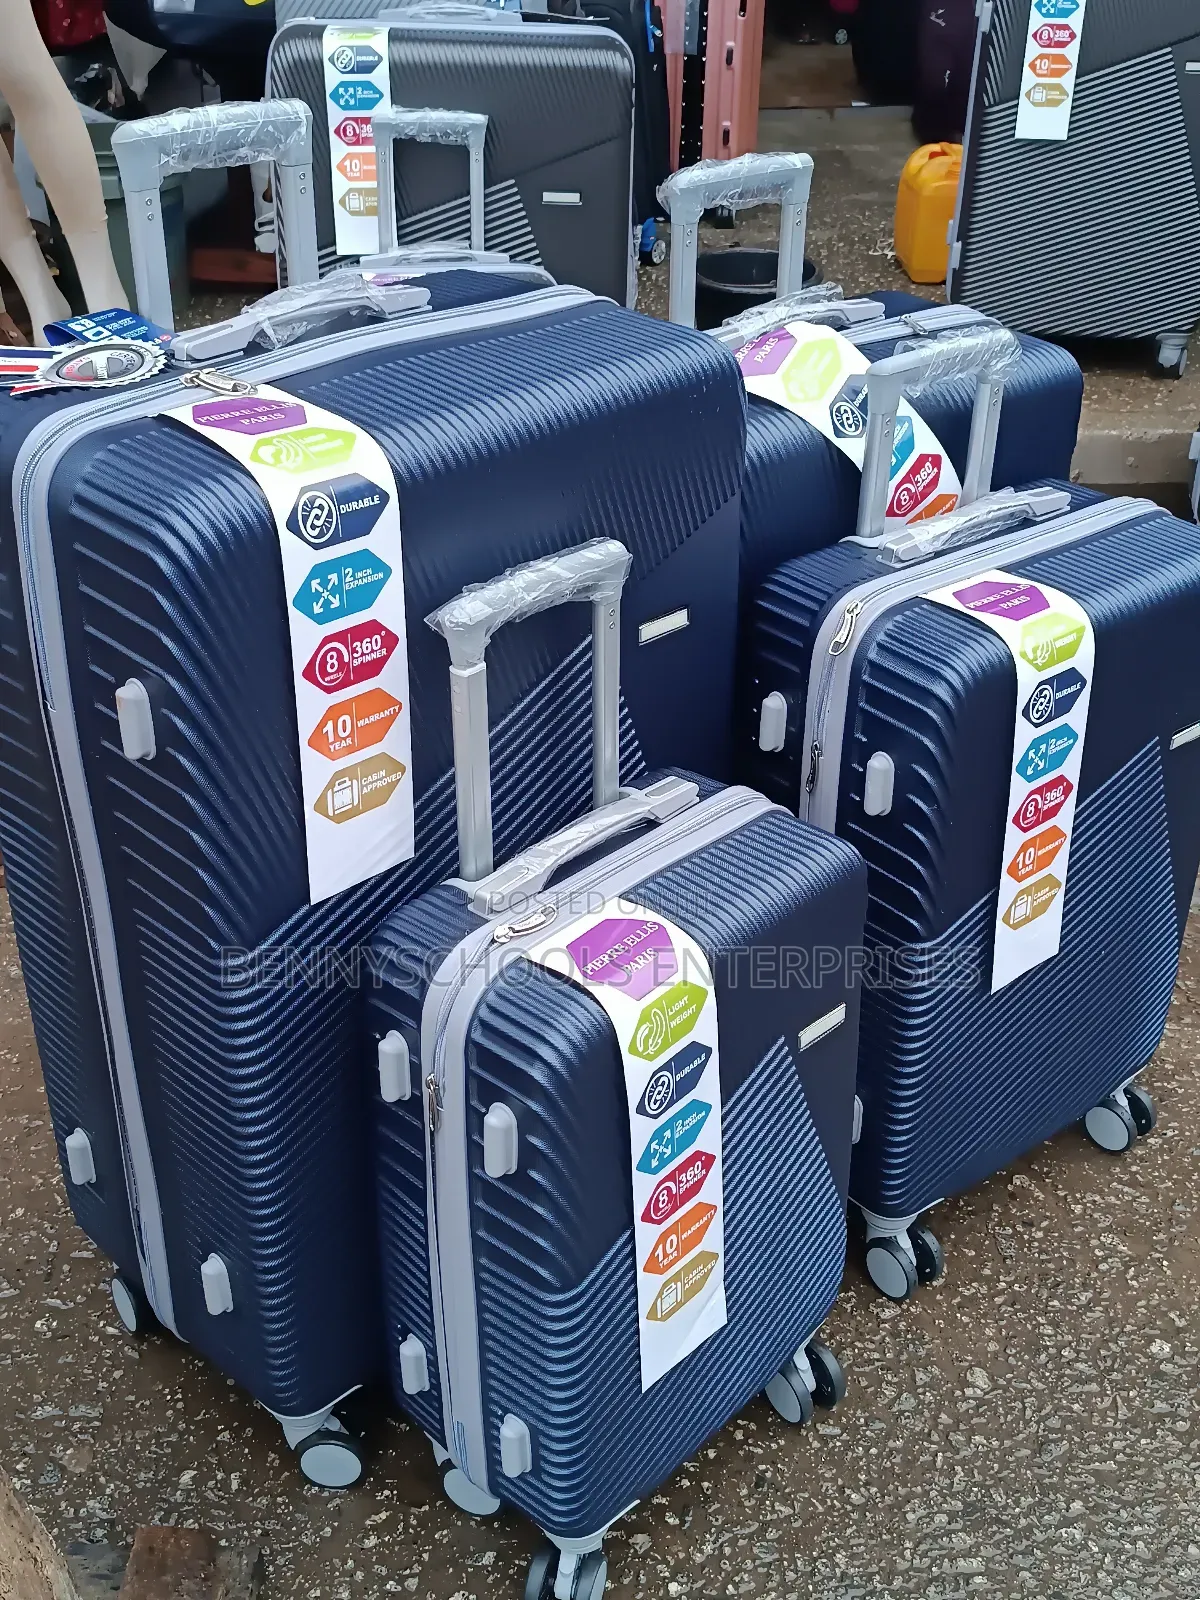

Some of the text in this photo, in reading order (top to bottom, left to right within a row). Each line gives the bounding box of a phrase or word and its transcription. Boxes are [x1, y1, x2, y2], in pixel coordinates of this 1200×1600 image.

[1034, 59, 1049, 70] 10
[346, 125, 354, 136] 8
[343, 159, 361, 172] 10
[239, 412, 286, 426] PARIS
[339, 494, 381, 515] DURABLE
[900, 490, 910, 506] 8
[345, 567, 373, 583] 2 INCH
[345, 572, 384, 591] EXPANSION
[352, 630, 386, 658] 360°
[326, 651, 339, 673] 8
[352, 648, 387, 667] SPINNER
[357, 704, 400, 728] WARRANTY
[322, 714, 352, 743] 10
[328, 737, 353, 753] YEAR
[1050, 738, 1056, 748] 2
[361, 769, 386, 786] CABIN
[362, 771, 402, 795] APPROVED
[1026, 801, 1036, 818] 8
[1016, 847, 1035, 870] 10
[1033, 886, 1050, 900] CABIN
[582, 921, 660, 976] PIERRE ELLIS
[621, 947, 659, 978] PARIS
[667, 995, 689, 1016] LIGHT
[669, 1004, 697, 1029] WEIGHT
[675, 1052, 706, 1082] DURABLE
[675, 1119, 683, 1131] 2
[679, 1168, 706, 1195] SPINNER
[658, 1189, 669, 1209] 8
[681, 1208, 715, 1241] WARRANTY
[654, 1233, 678, 1263] 10
[659, 1251, 678, 1269] YEAR
[684, 1263, 704, 1284] CABIN
[684, 1259, 716, 1291] APPROVED
